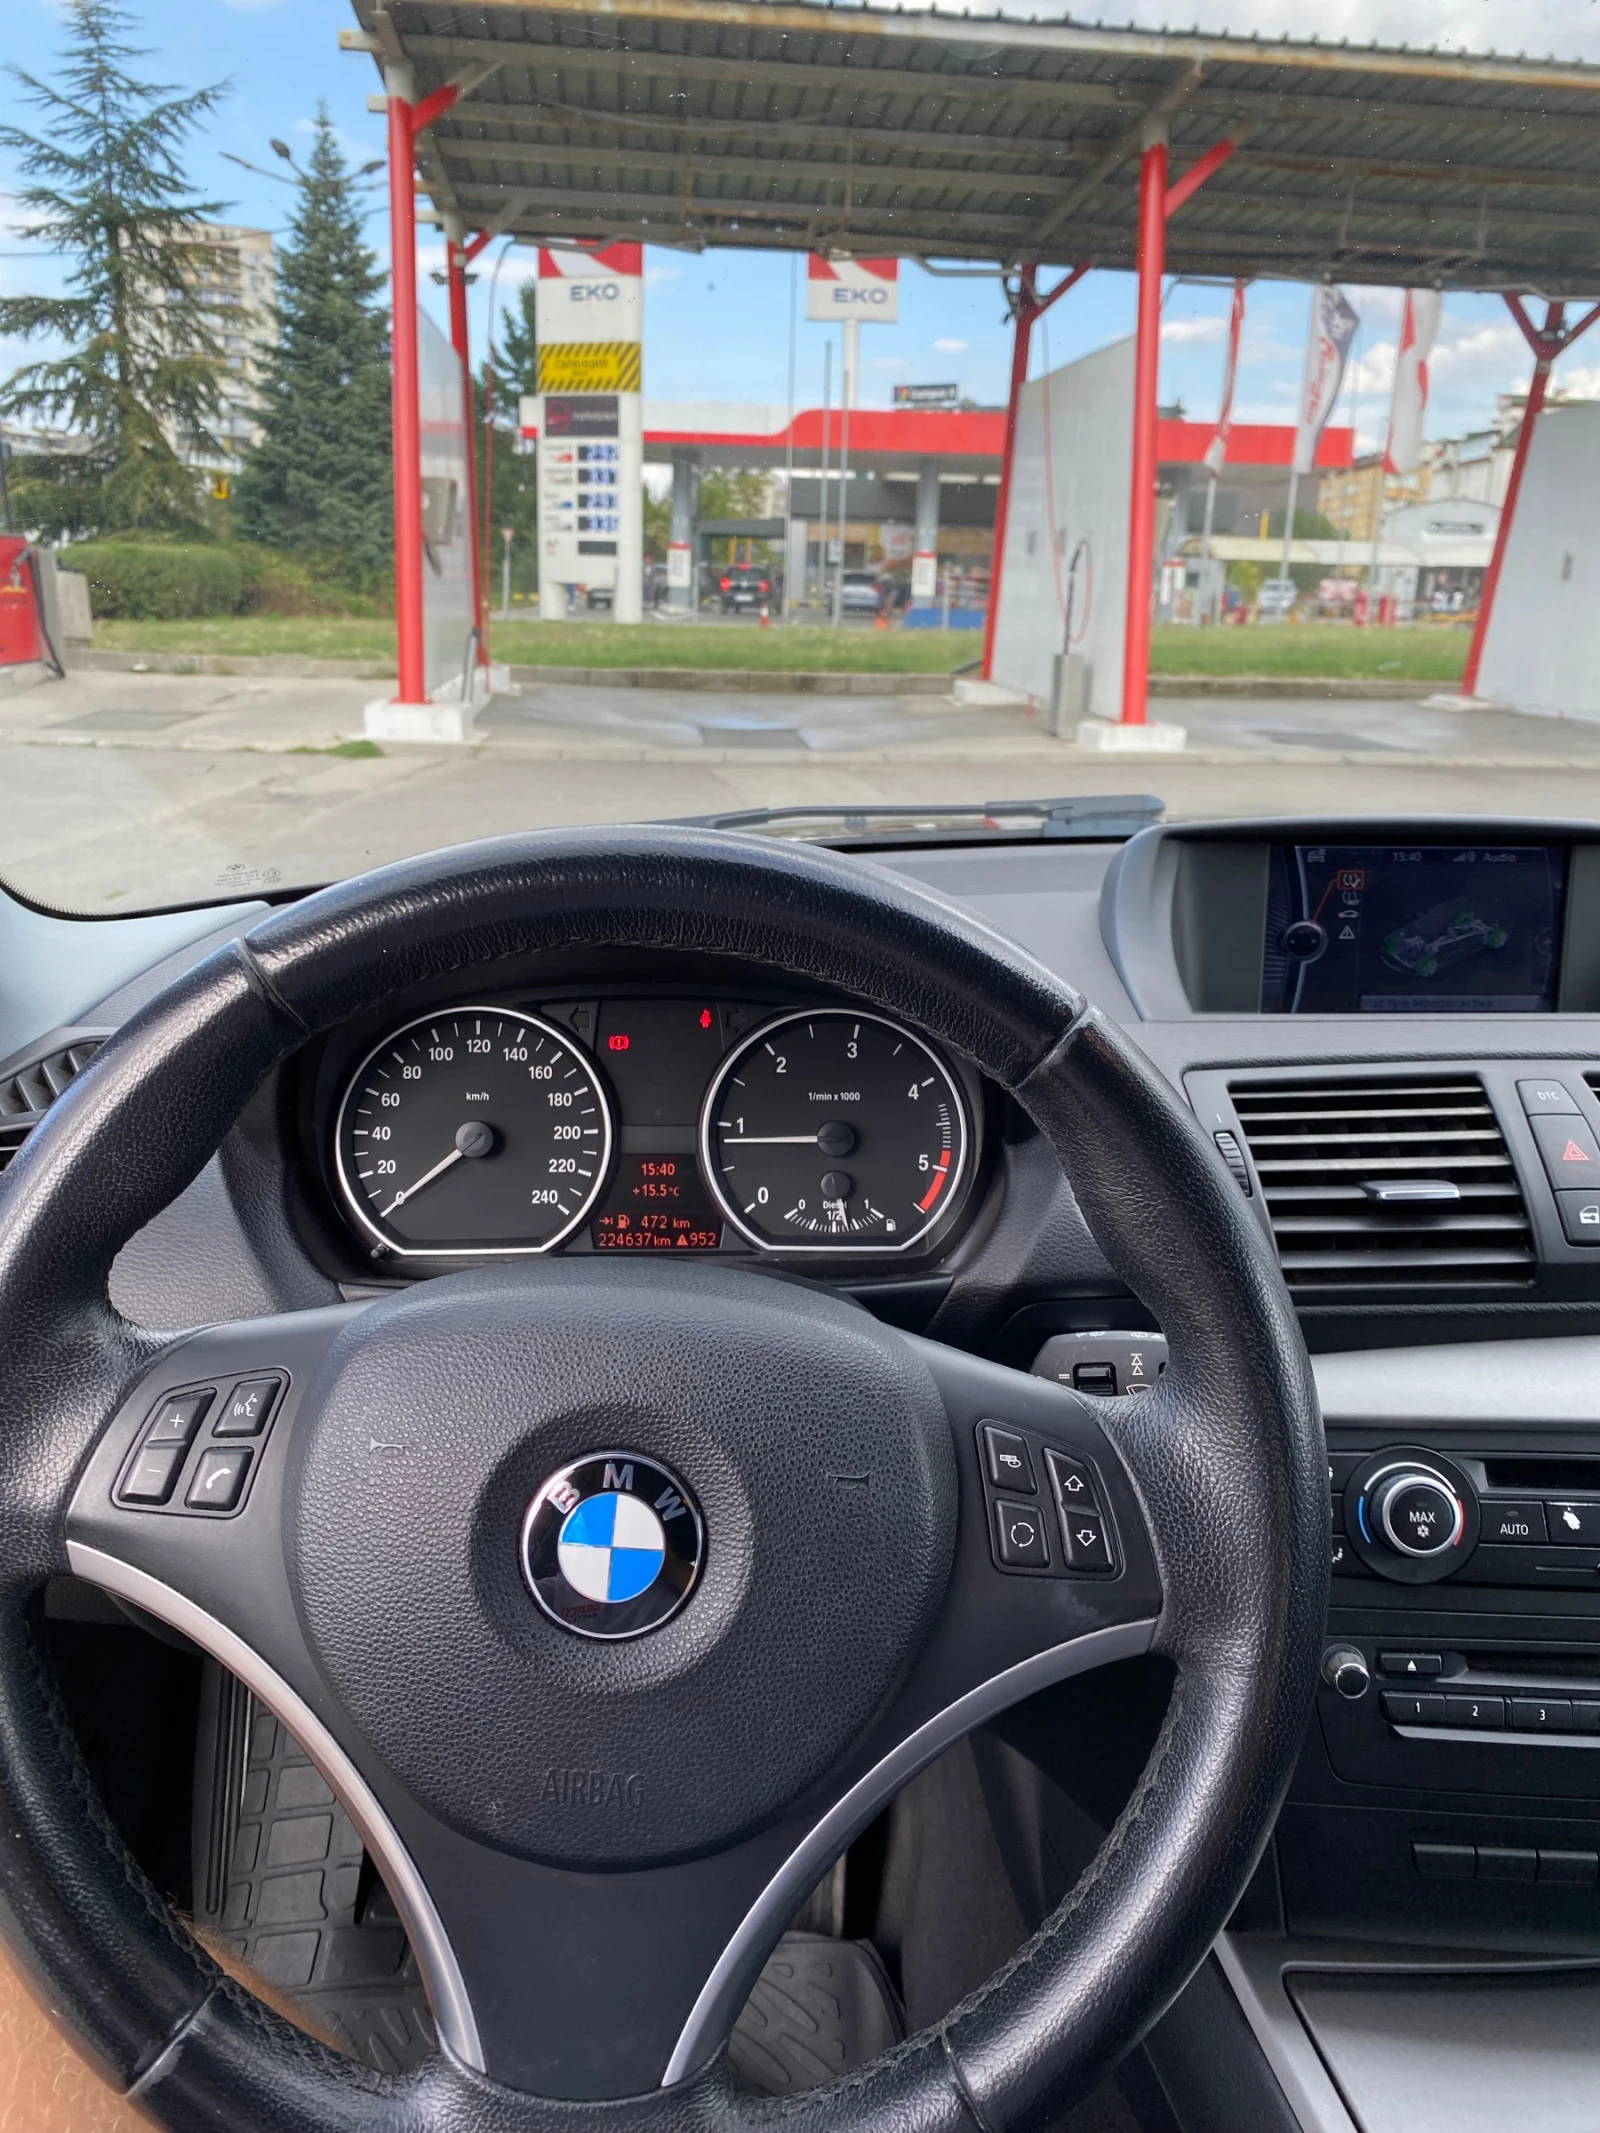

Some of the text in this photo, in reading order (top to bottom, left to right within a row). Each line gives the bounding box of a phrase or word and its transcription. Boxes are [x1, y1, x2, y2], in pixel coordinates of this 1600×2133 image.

[570, 283, 620, 301] EKO
[833, 287, 888, 304] EKO
[1393, 852, 1422, 862] 15:40
[1483, 852, 1516, 863] Audio
[466, 1039, 491, 1053] 120
[846, 1042, 858, 1058] 3
[428, 1047, 453, 1061] 100
[503, 1047, 528, 1061] 140
[776, 1057, 787, 1073] 2
[402, 1066, 422, 1080] 80
[528, 1066, 553, 1080] 160
[466, 1092, 489, 1101] km/h
[808, 1092, 831, 1101] 1/min
[840, 1092, 860, 1101] 1000
[908, 1084, 919, 1100] 4
[1536, 1091, 1560, 1100] DTC
[381, 1093, 400, 1107] 60
[547, 1093, 572, 1107] 180
[553, 1126, 581, 1140] 200
[736, 1118, 744, 1134] 1
[372, 1127, 391, 1140] 40
[377, 1160, 396, 1174] 20
[548, 1159, 576, 1173] 220
[641, 1163, 675, 1176] 15:40
[918, 1155, 929, 1171] 5
[531, 1190, 558, 1204] 240
[757, 1187, 769, 1203] 0
[799, 1200, 806, 1209] 0
[864, 1200, 869, 1209] 1
[641, 1215, 691, 1229] 472 km
[827, 1211, 842, 1221] 1/2
[598, 1232, 716, 1247] 224637 km 952
[548, 1462, 687, 1522] BMW
[1409, 1511, 1436, 1523] MAX
[1500, 1524, 1529, 1536] AUTO
[1415, 1702, 1421, 1713] 1
[1472, 1706, 1479, 1717] 2
[1539, 1710, 1546, 1721] 3
[541, 1770, 645, 1808] AIRBAG
